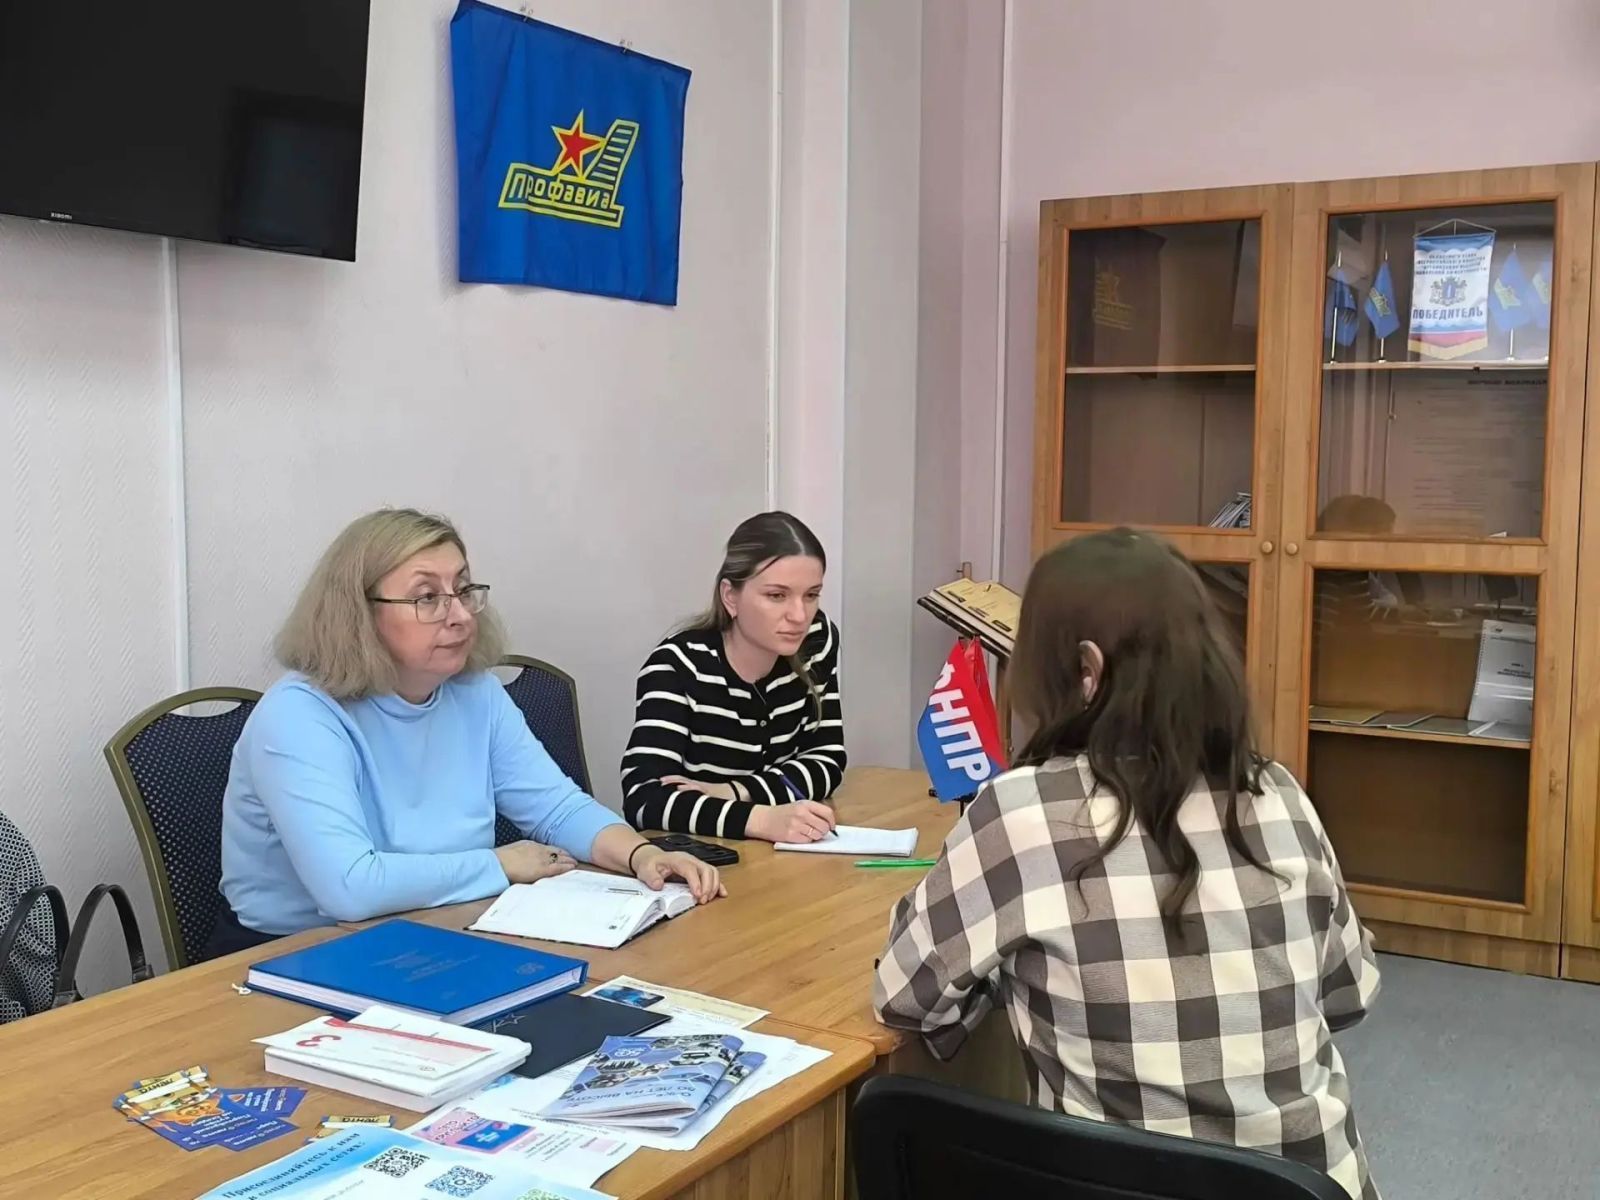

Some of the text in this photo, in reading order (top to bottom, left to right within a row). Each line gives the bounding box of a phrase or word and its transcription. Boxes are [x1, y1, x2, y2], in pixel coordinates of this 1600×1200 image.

[508, 172, 611, 210] Профавиа
[1412, 306, 1483, 320] ПОБЕДИТЕЛЬ
[258, 1159, 331, 1198] социальных
